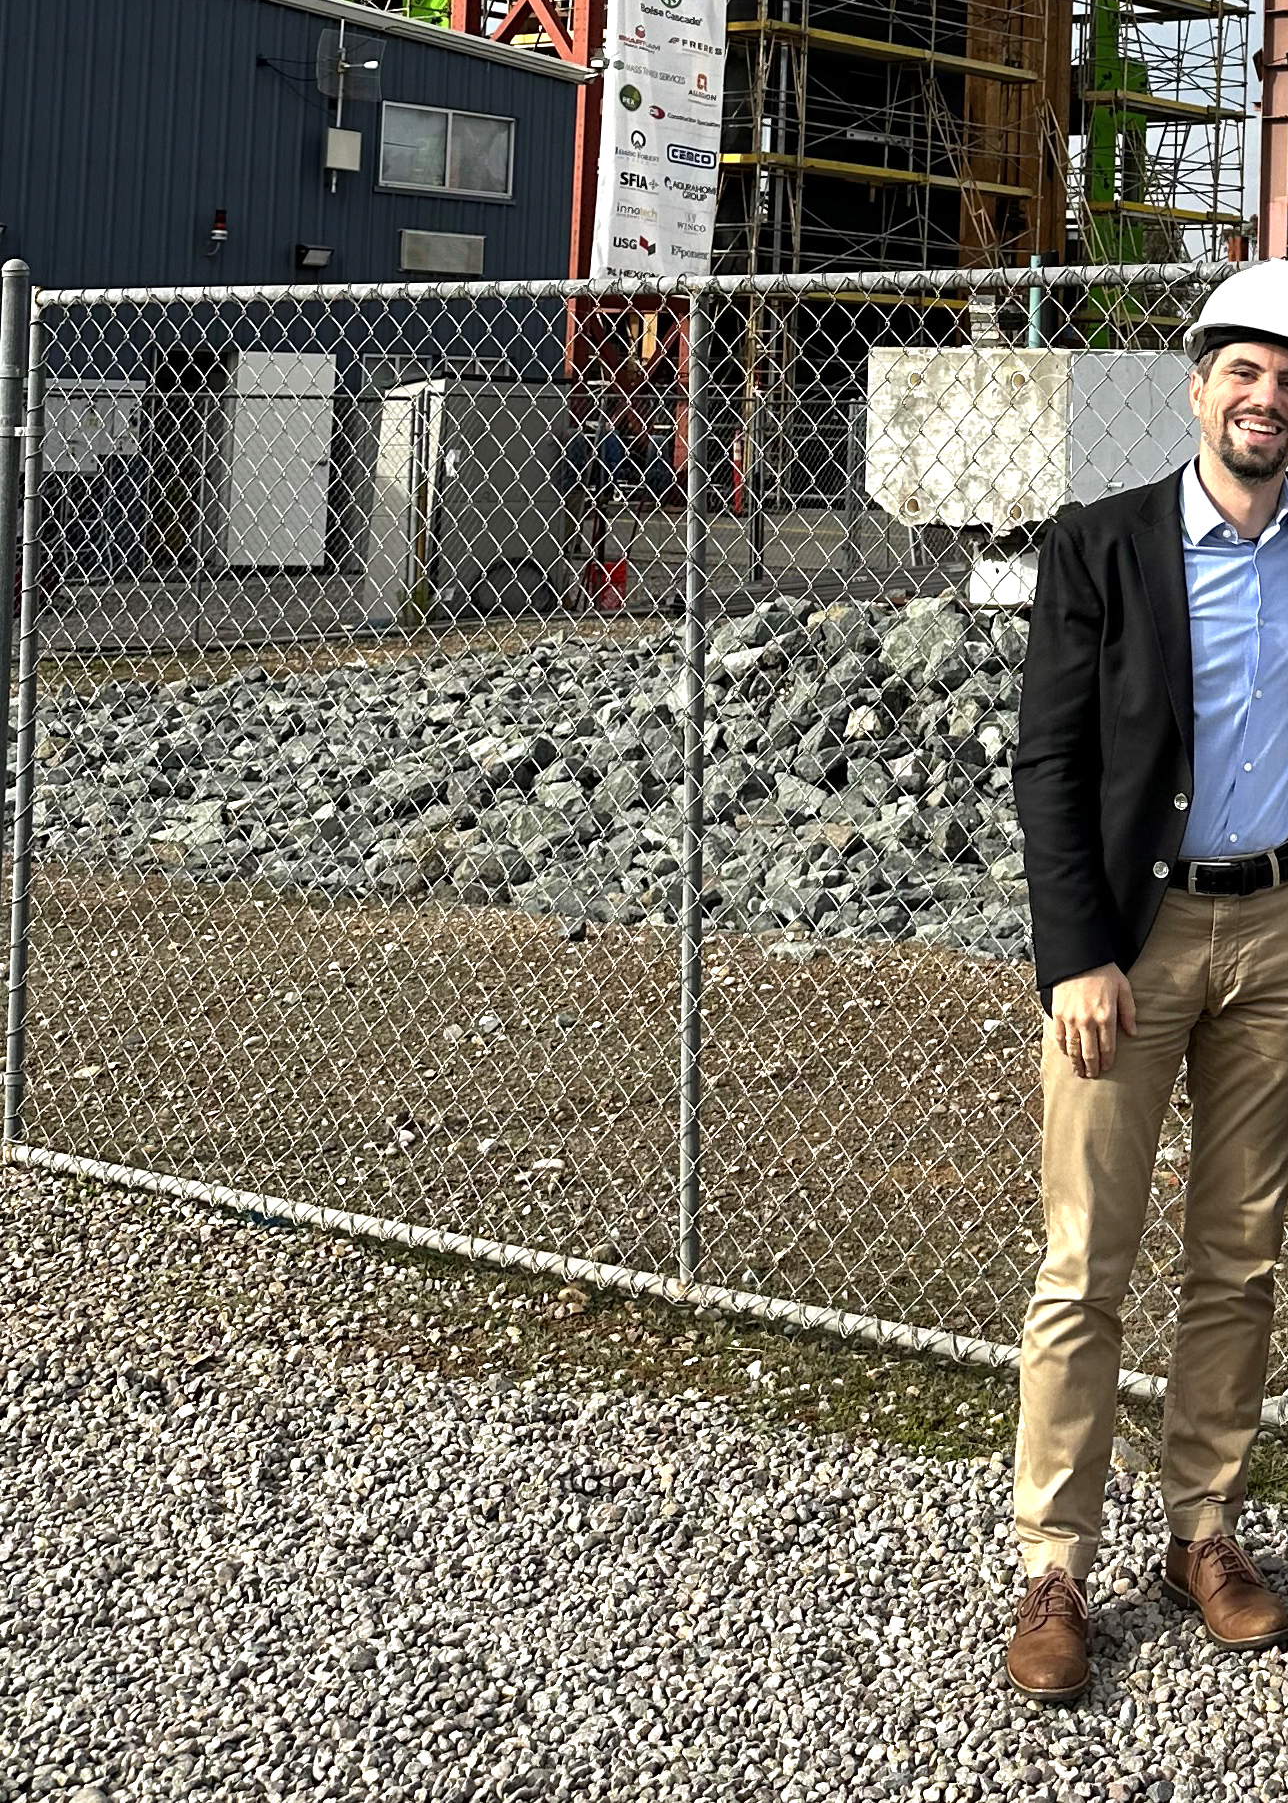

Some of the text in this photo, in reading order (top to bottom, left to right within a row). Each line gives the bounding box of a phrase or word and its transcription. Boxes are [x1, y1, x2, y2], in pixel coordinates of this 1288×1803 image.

[640, 2, 664, 17] Boise
[671, 148, 711, 165] CEMCO
[620, 171, 648, 190] SFIA
[682, 191, 708, 201] GROUP
[677, 222, 706, 233] WINCO
[613, 236, 637, 250] USG
